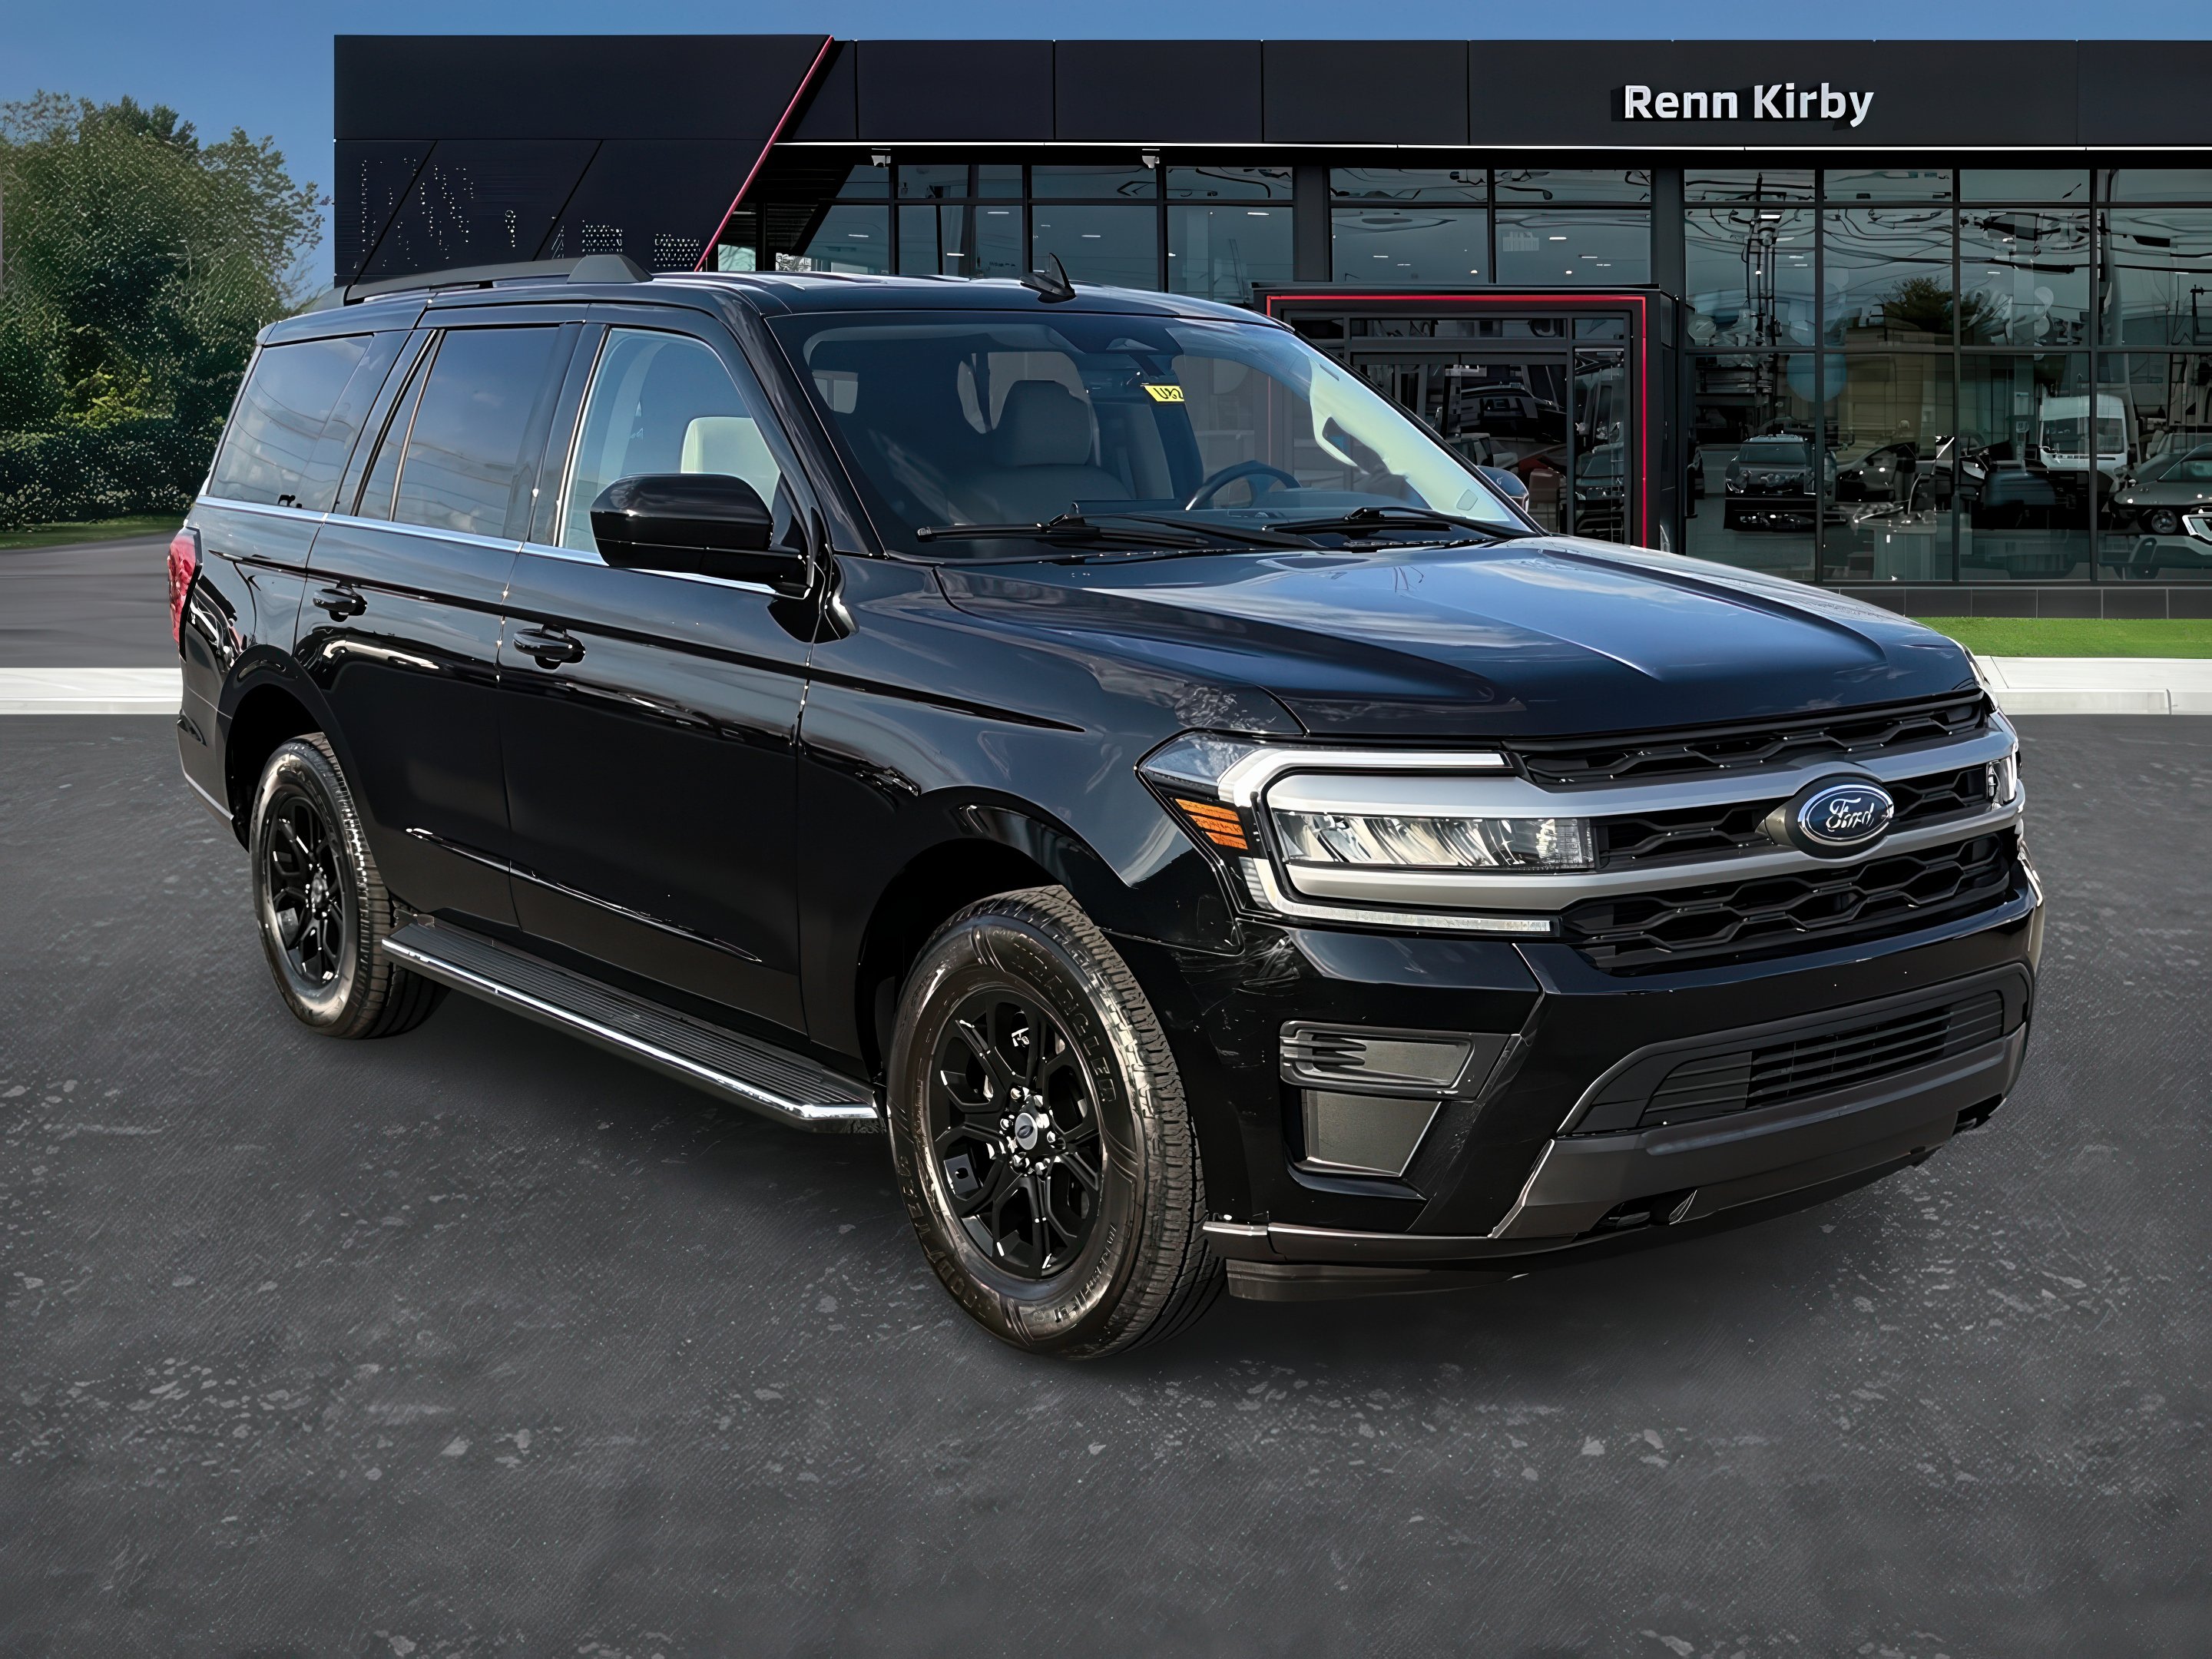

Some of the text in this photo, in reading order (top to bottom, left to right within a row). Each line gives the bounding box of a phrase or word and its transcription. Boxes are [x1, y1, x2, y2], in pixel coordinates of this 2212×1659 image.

[1624, 82, 1875, 127] Renn Kirby
[1826, 797, 1875, 832] Ford
